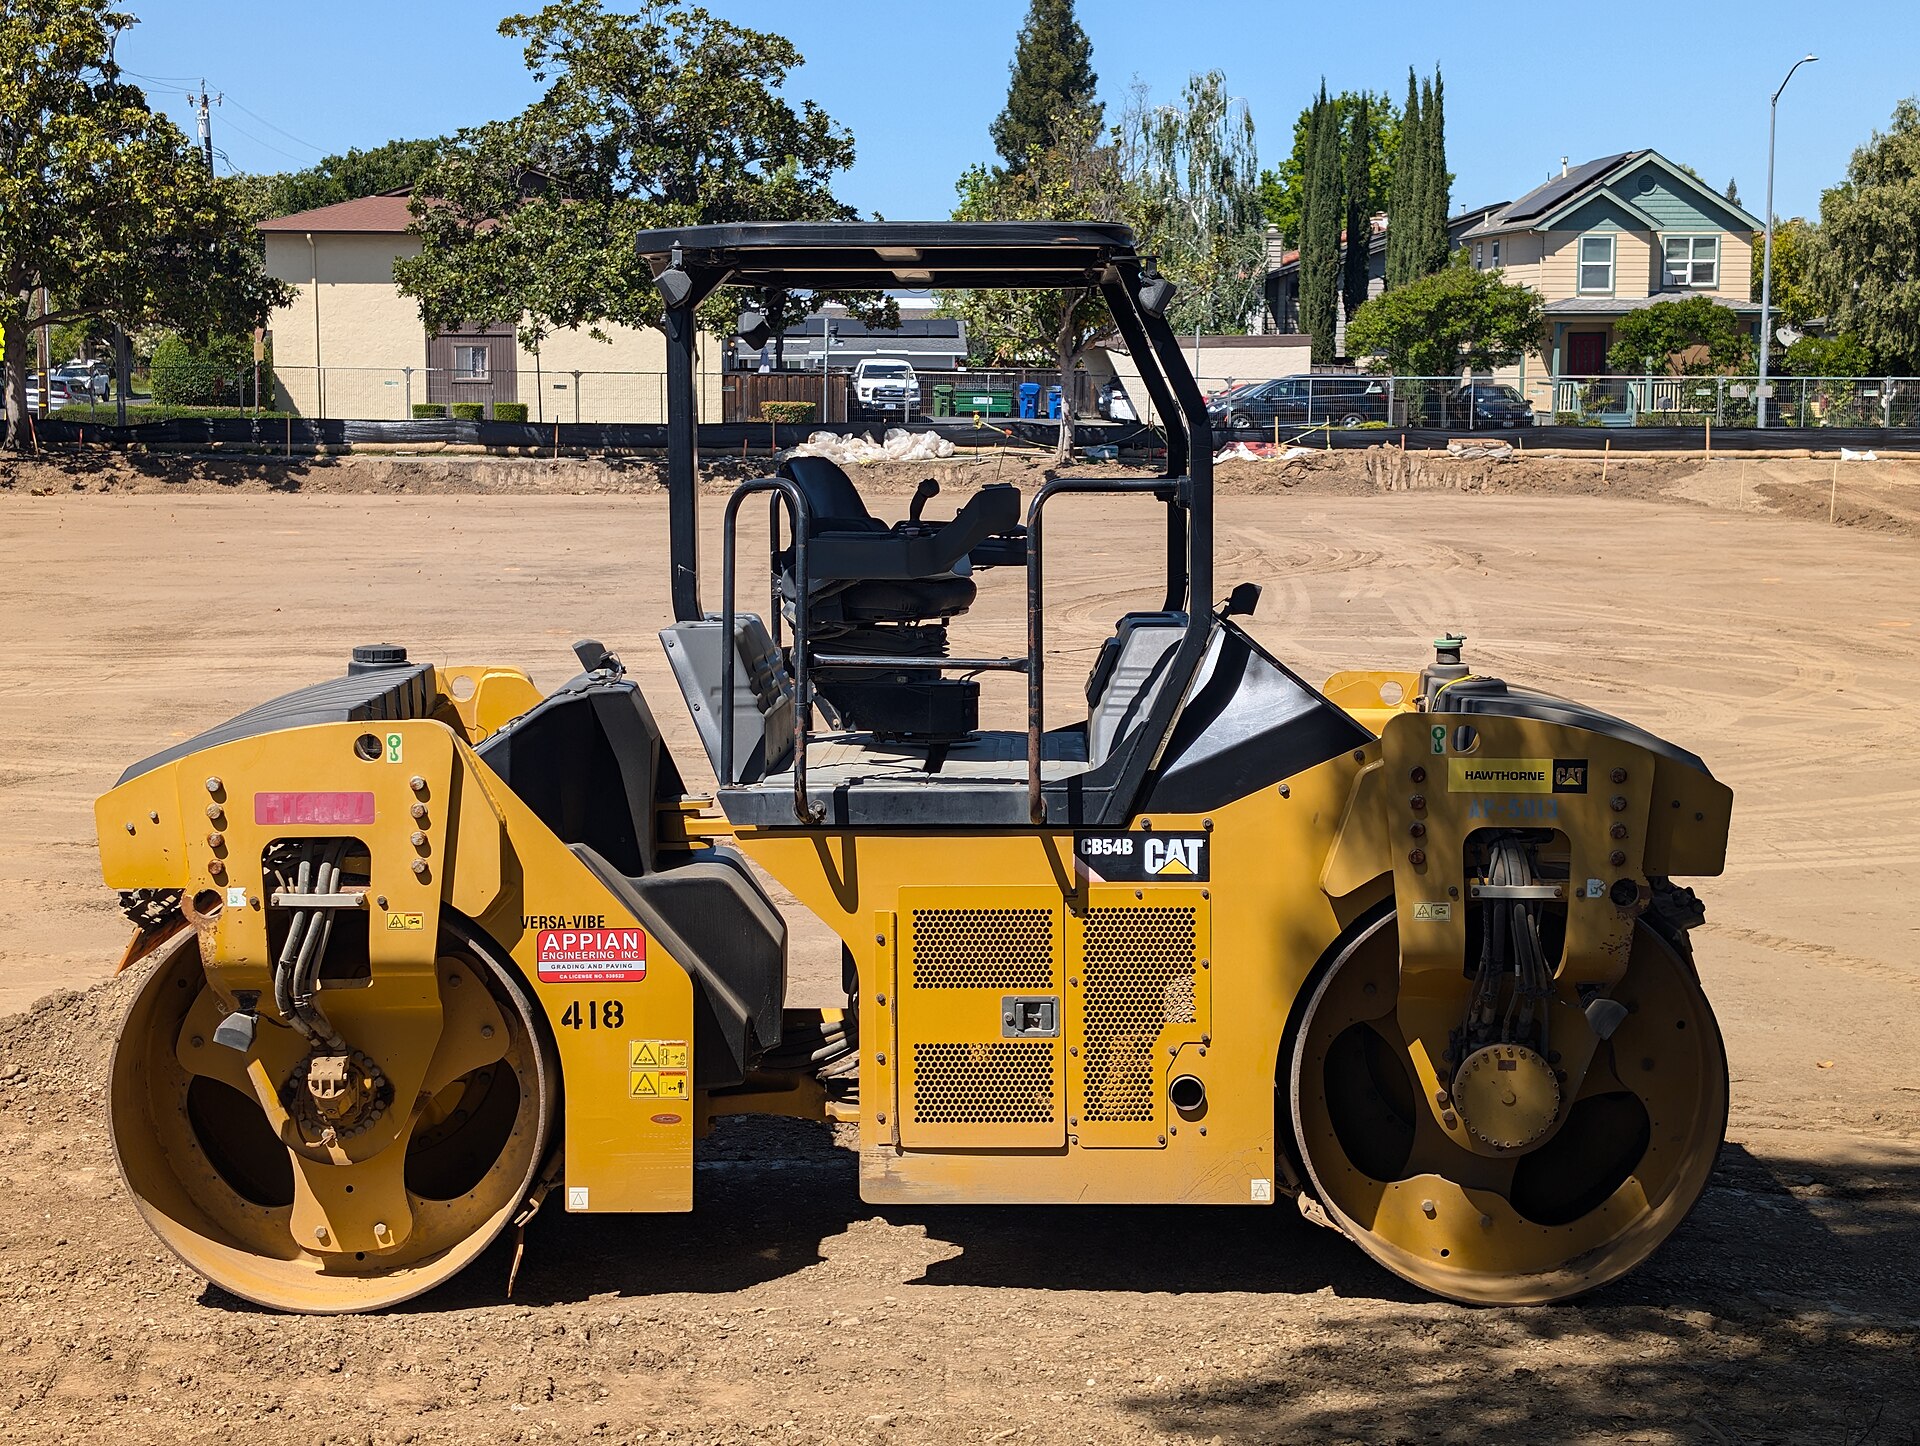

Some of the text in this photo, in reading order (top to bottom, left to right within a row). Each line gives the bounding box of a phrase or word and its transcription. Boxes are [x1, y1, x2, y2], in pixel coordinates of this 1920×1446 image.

[1465, 767, 1584, 786] HAWTHORNE CAT
[1081, 838, 1204, 875] CB54B CAT
[520, 915, 605, 929] VERSA-VIBE
[543, 933, 638, 950] APPIAN
[541, 950, 639, 960] ENGINEERING INC
[561, 1000, 624, 1029] 418
